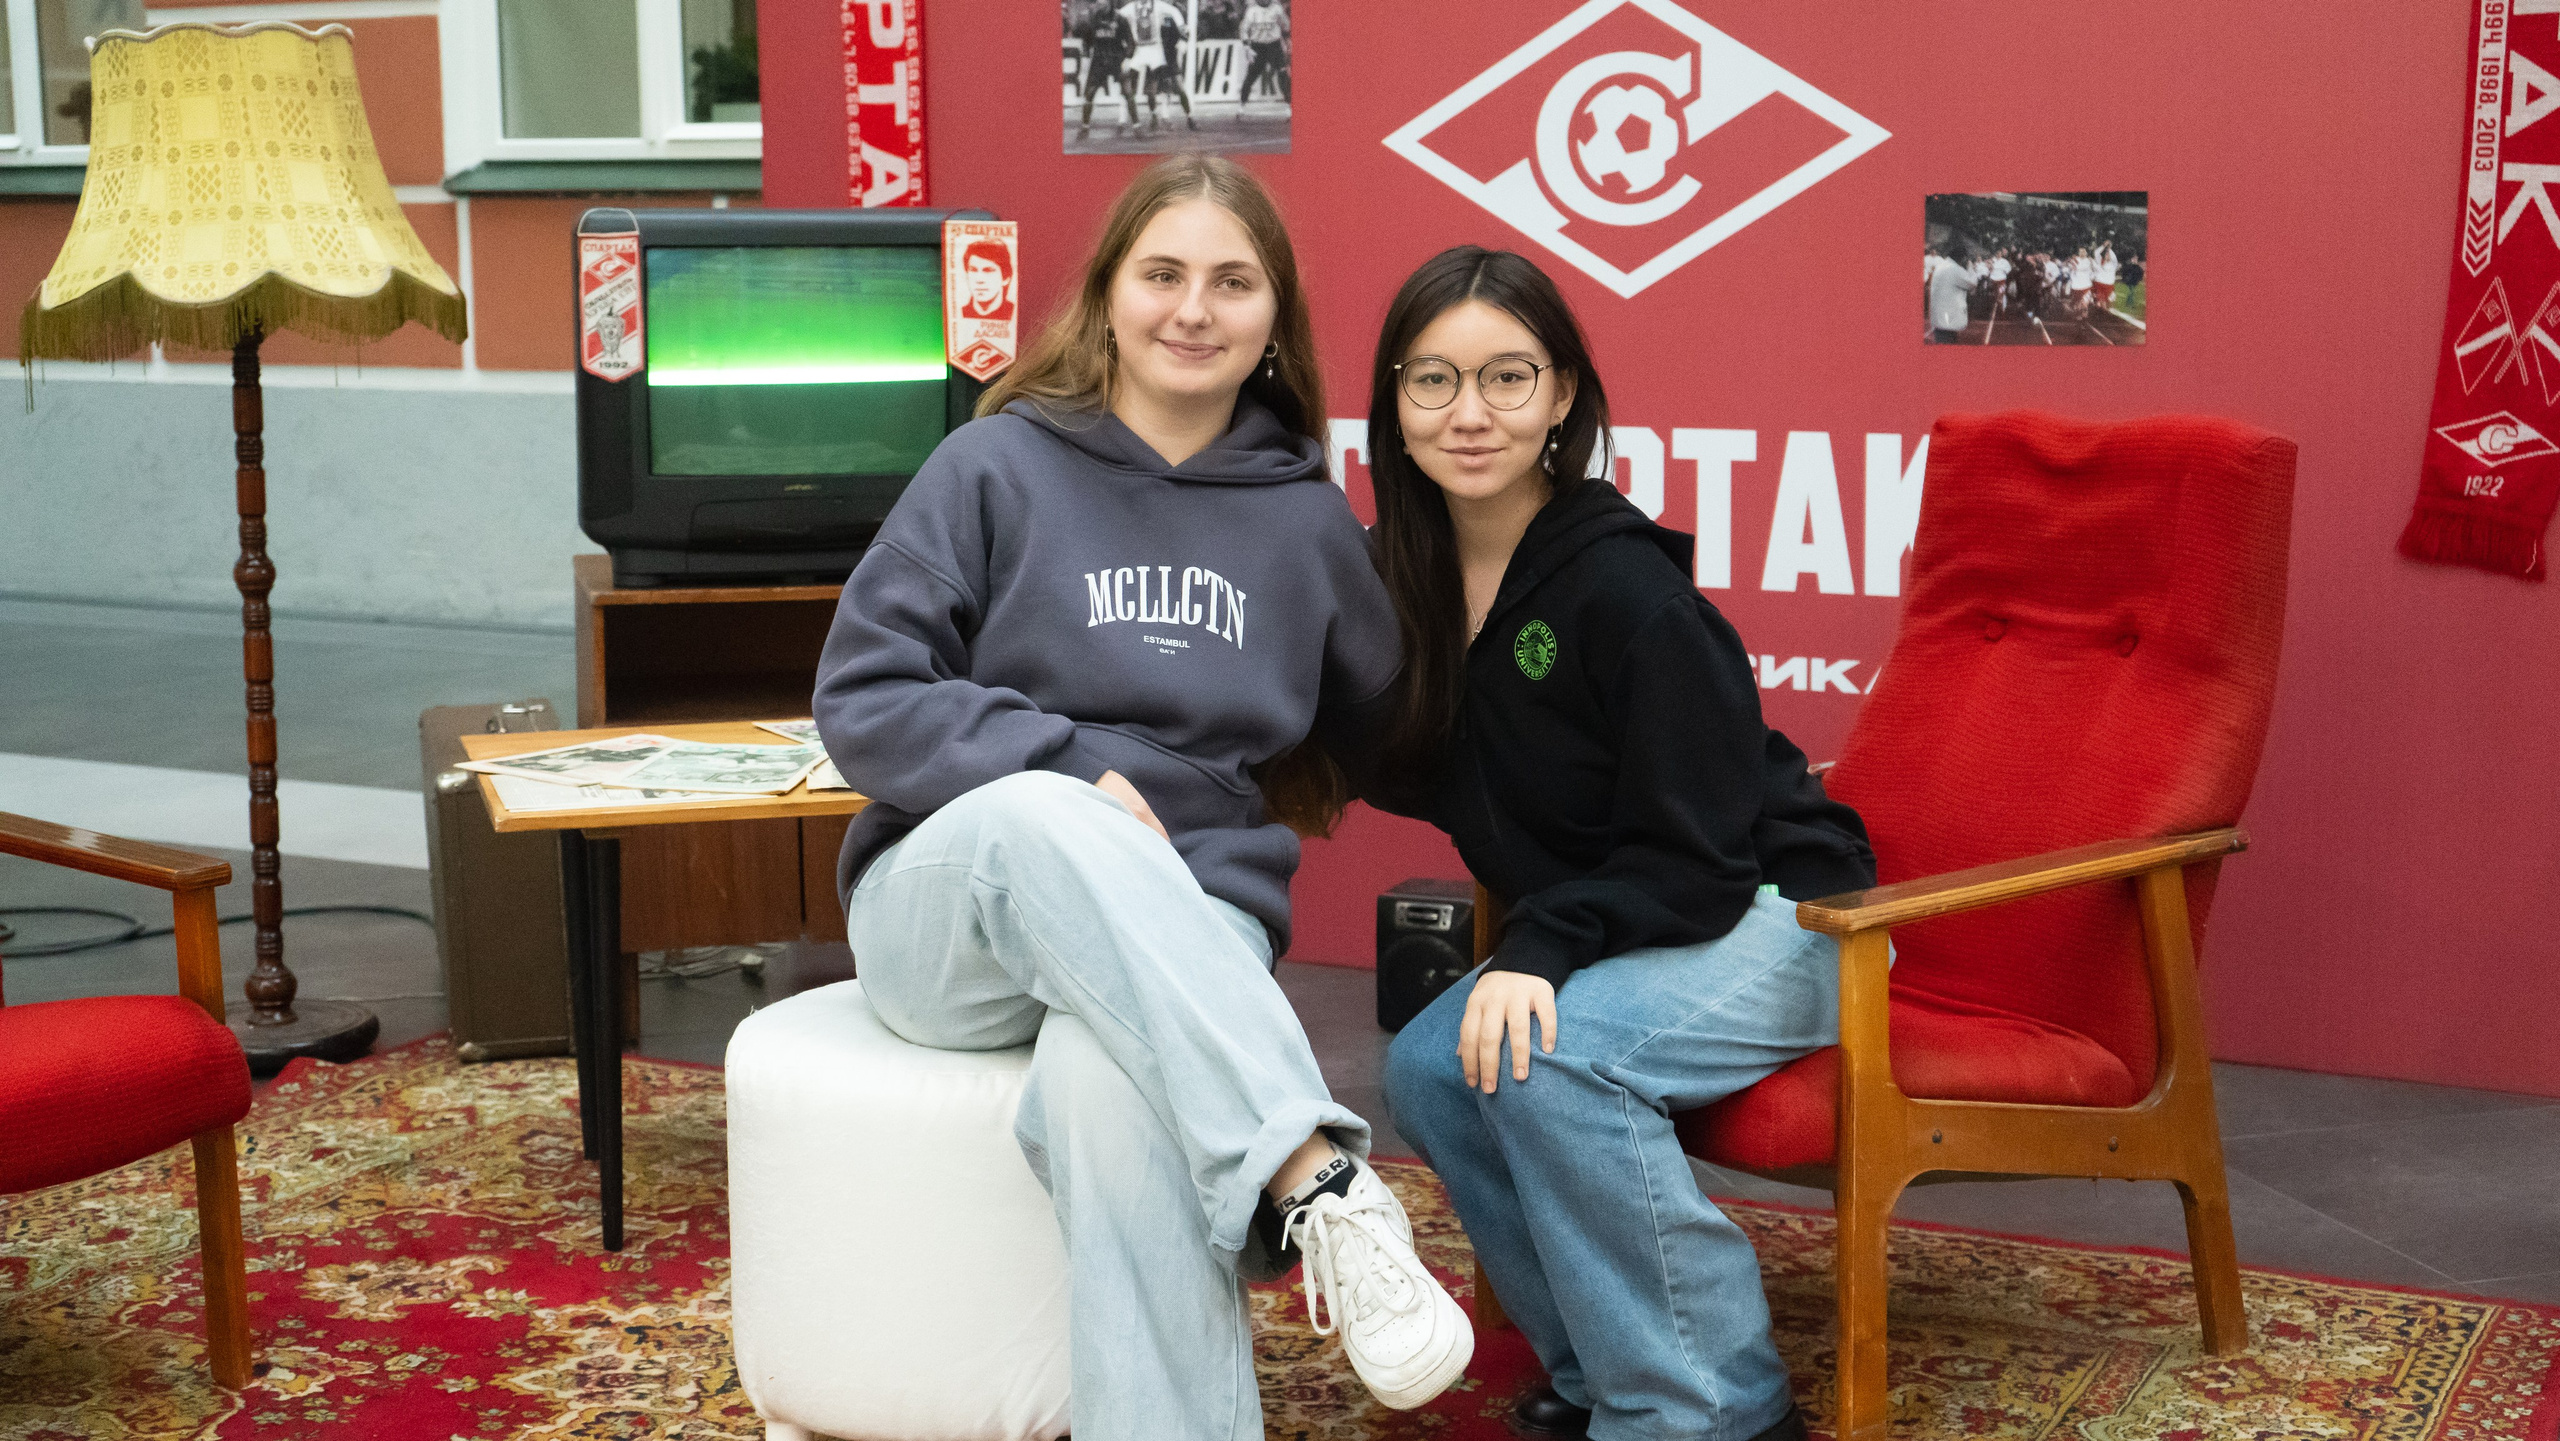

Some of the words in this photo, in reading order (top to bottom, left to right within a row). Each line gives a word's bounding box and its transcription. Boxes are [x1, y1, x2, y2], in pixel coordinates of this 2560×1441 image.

[2474, 117, 2496, 172] 2003
[600, 361, 629, 370] 1992
[2464, 475, 2504, 497] 1922
[1084, 565, 1246, 650] MCLLCTN
[1143, 635, 1190, 649] ESTAMBUL
[1520, 623, 1554, 649] INNOPOLIS
[1517, 650, 1551, 678] UNIVERSITY
